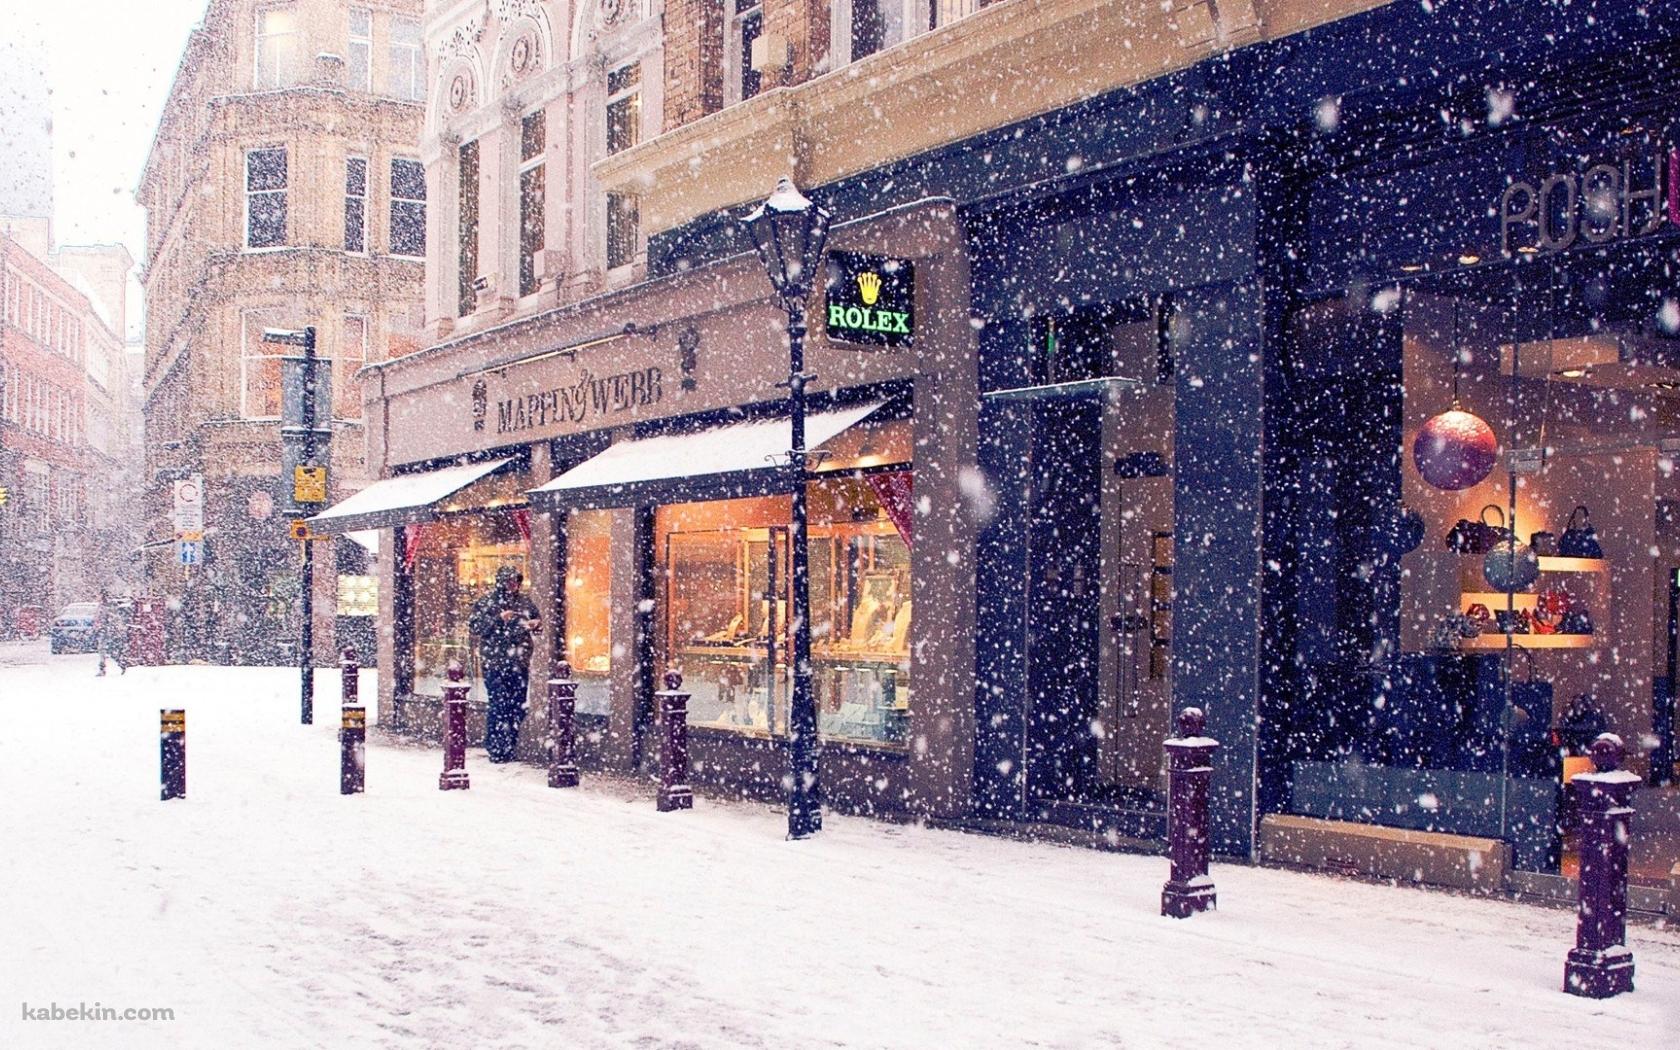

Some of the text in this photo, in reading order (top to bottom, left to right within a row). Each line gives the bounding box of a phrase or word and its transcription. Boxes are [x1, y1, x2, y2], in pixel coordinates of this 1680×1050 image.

[1501, 153, 1661, 258] POSH
[829, 304, 910, 333] ROLEX
[497, 386, 576, 434] MAPPIN
[591, 367, 662, 414] WEBB
